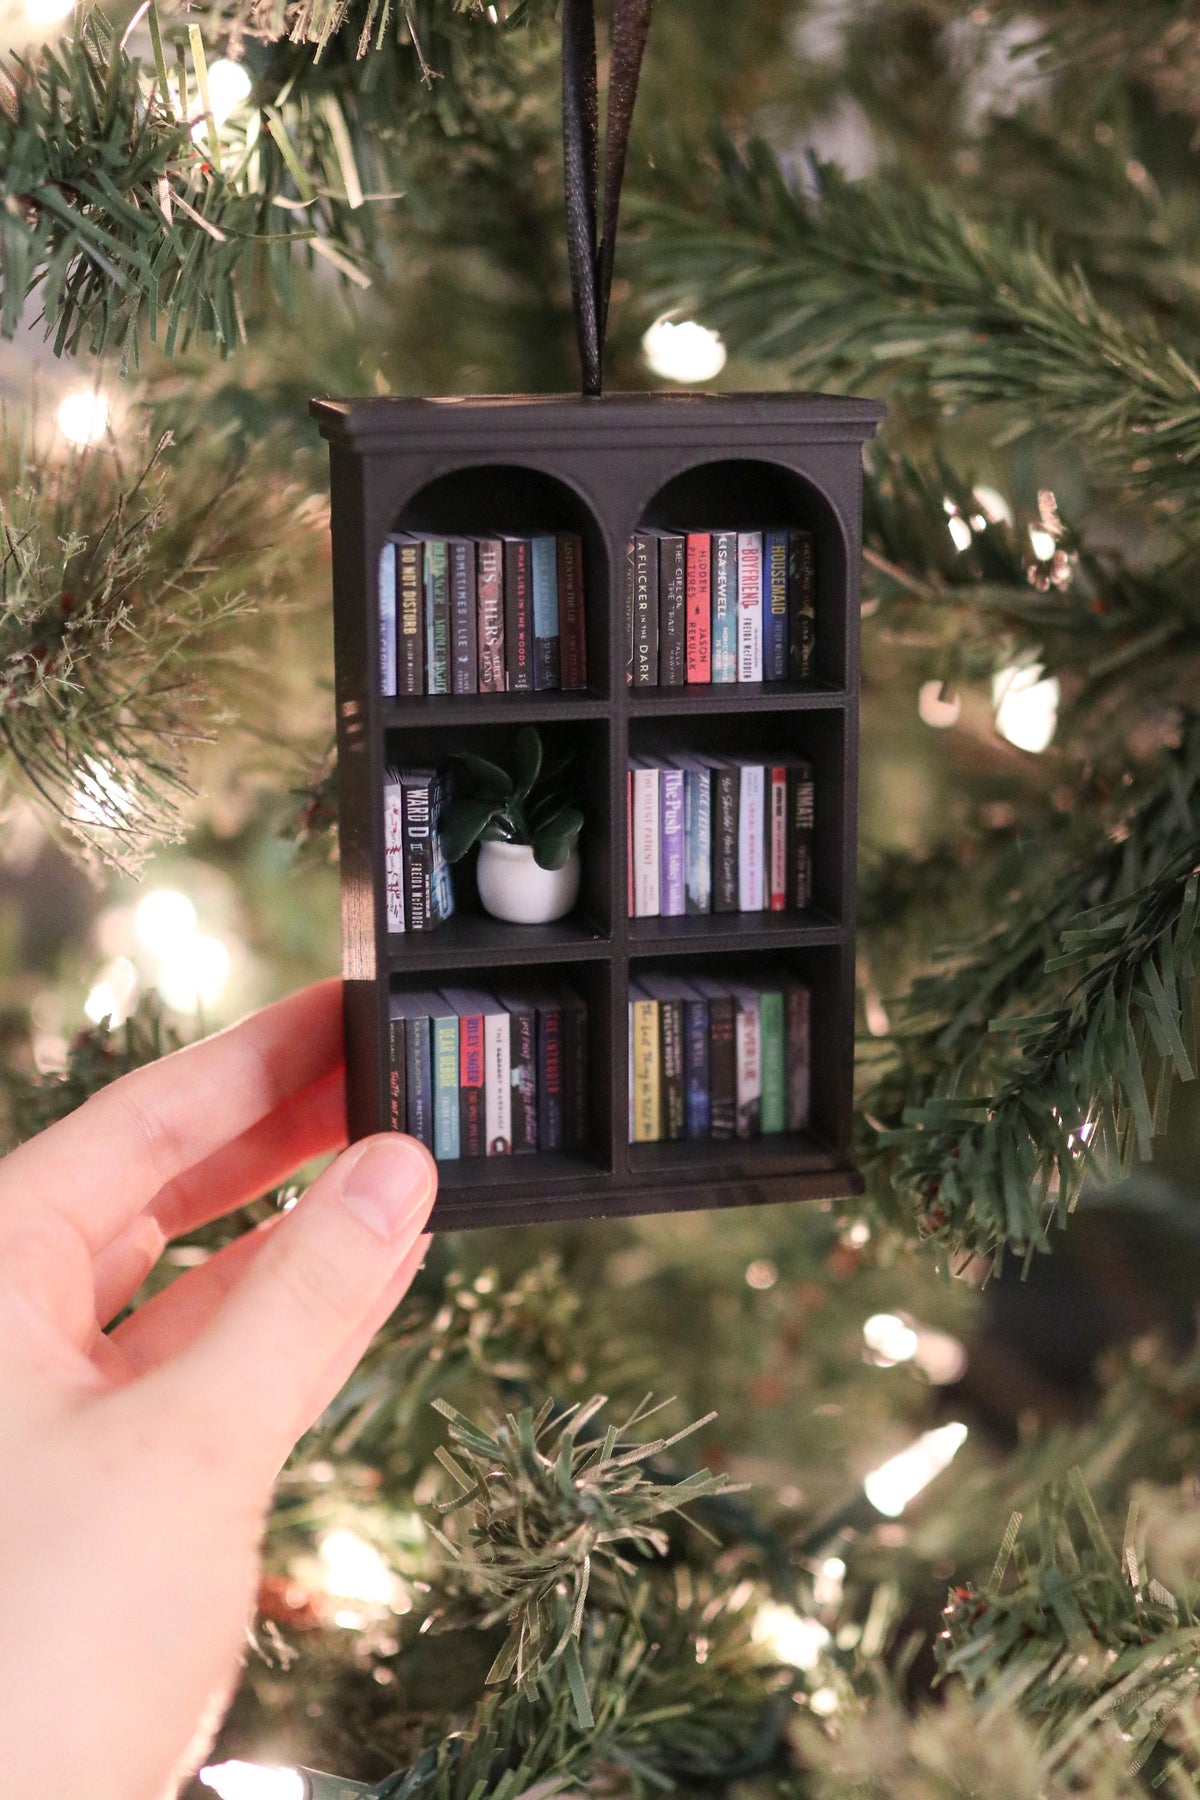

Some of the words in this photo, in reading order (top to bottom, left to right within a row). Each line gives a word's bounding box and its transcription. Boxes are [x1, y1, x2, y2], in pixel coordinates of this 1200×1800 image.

[402, 548, 416, 563] DO
[638, 543, 645, 551] A
[718, 537, 728, 566] LISA
[402, 566, 416, 587] NOT
[456, 547, 468, 615] SOMETIMES
[483, 552, 496, 583] HIS
[638, 555, 648, 610] FLICKER
[675, 568, 683, 590] GIRL
[741, 548, 760, 609] BOYFRIEND
[771, 545, 786, 615] HOUSEMAID
[518, 600, 525, 609] IN
[718, 569, 728, 619] JEWELL
[402, 592, 417, 635] DISTURB
[485, 600, 498, 646] HERS
[743, 618, 752, 641] FREIDA
[458, 629, 468, 647] LIE
[688, 622, 697, 671] REKULAK
[699, 627, 708, 664] JASON
[639, 645, 649, 682] DARK
[743, 645, 752, 679] McFADDEN
[644, 773, 653, 788] THE
[665, 770, 683, 799] The
[699, 775, 710, 805] ALICE
[721, 777, 732, 792] You
[406, 788, 429, 822] WARD
[644, 794, 653, 823] SILENT
[665, 800, 681, 835] Push
[722, 796, 734, 833] Shouldn't
[796, 782, 814, 829] INMATE
[407, 826, 429, 838] D
[644, 827, 653, 865] PATIENT
[411, 863, 423, 889] FREIDA
[412, 892, 424, 929] McFADDEN
[439, 1028, 455, 1052] DEAR
[467, 1018, 479, 1046] RILEY
[414, 1049, 422, 1096] SLAUGHTER
[439, 1055, 457, 1088] DEBBIE
[467, 1051, 480, 1083] SAGER
